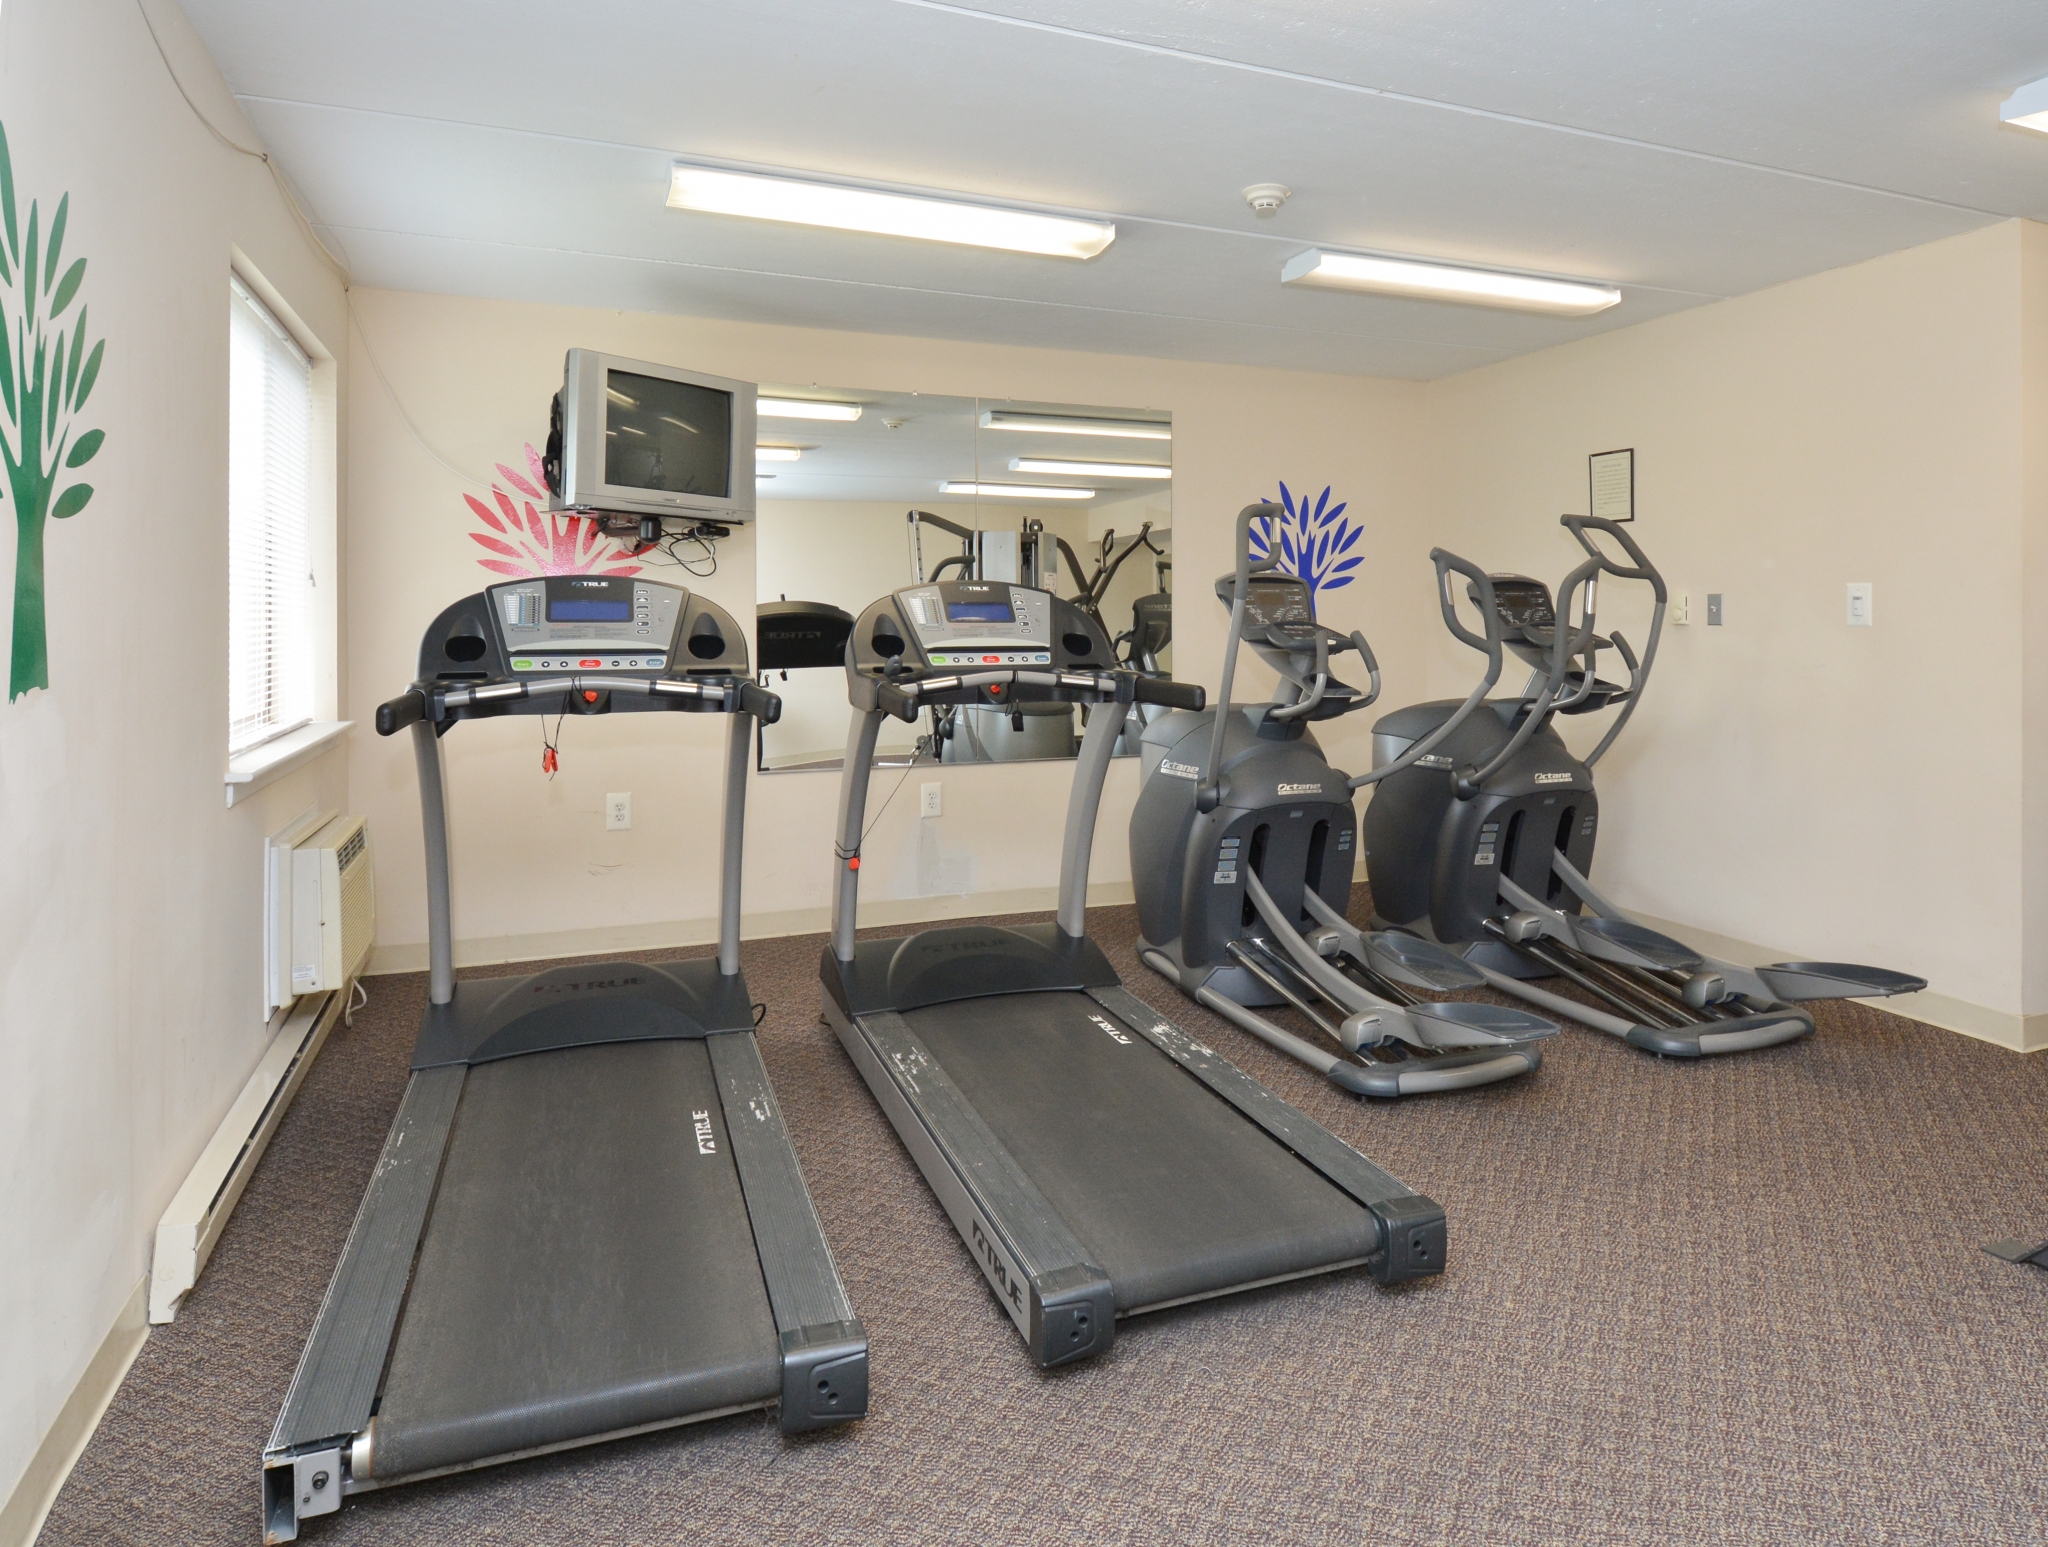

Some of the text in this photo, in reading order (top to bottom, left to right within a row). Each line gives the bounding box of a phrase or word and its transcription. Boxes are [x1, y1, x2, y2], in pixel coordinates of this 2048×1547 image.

[1161, 759, 1200, 773] Octane
[1535, 772, 1571, 780] Octane
[565, 977, 646, 990] TRUE
[693, 1110, 713, 1142] TRUE
[985, 1237, 1022, 1314] TRUE
